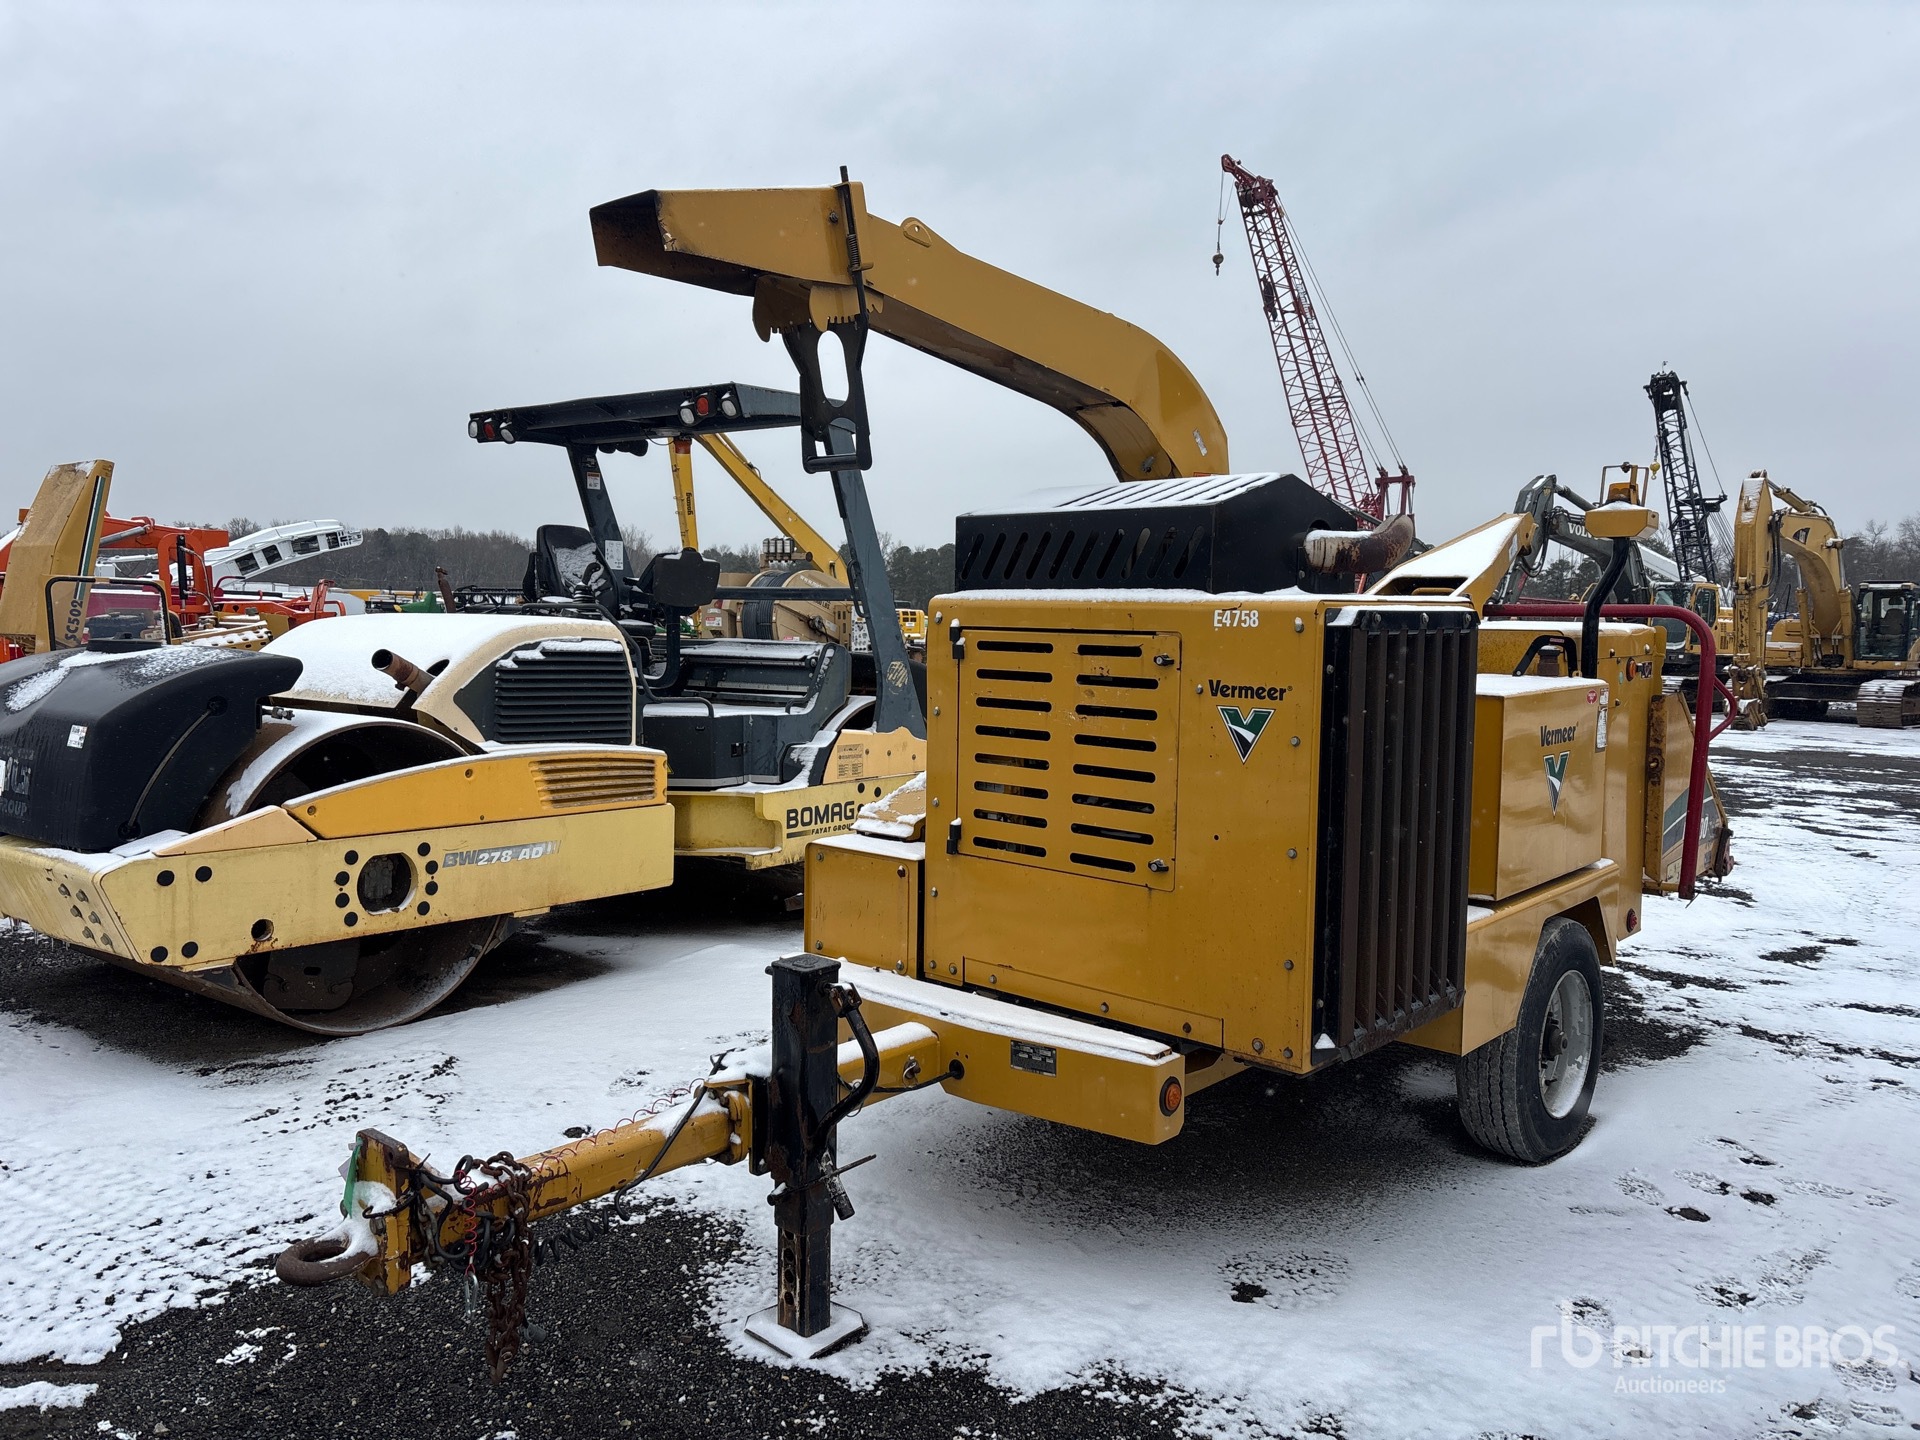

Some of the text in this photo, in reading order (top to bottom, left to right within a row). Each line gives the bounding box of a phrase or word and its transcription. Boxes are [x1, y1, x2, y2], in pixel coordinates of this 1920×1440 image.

[1567, 522, 1599, 541] VOL
[64, 600, 83, 644] SC502
[1213, 609, 1259, 628] E4758
[1540, 724, 1577, 747] Vermeer
[0, 798, 28, 817] ROUP
[786, 800, 855, 830] BOMAG
[811, 826, 832, 835] FAYAT
